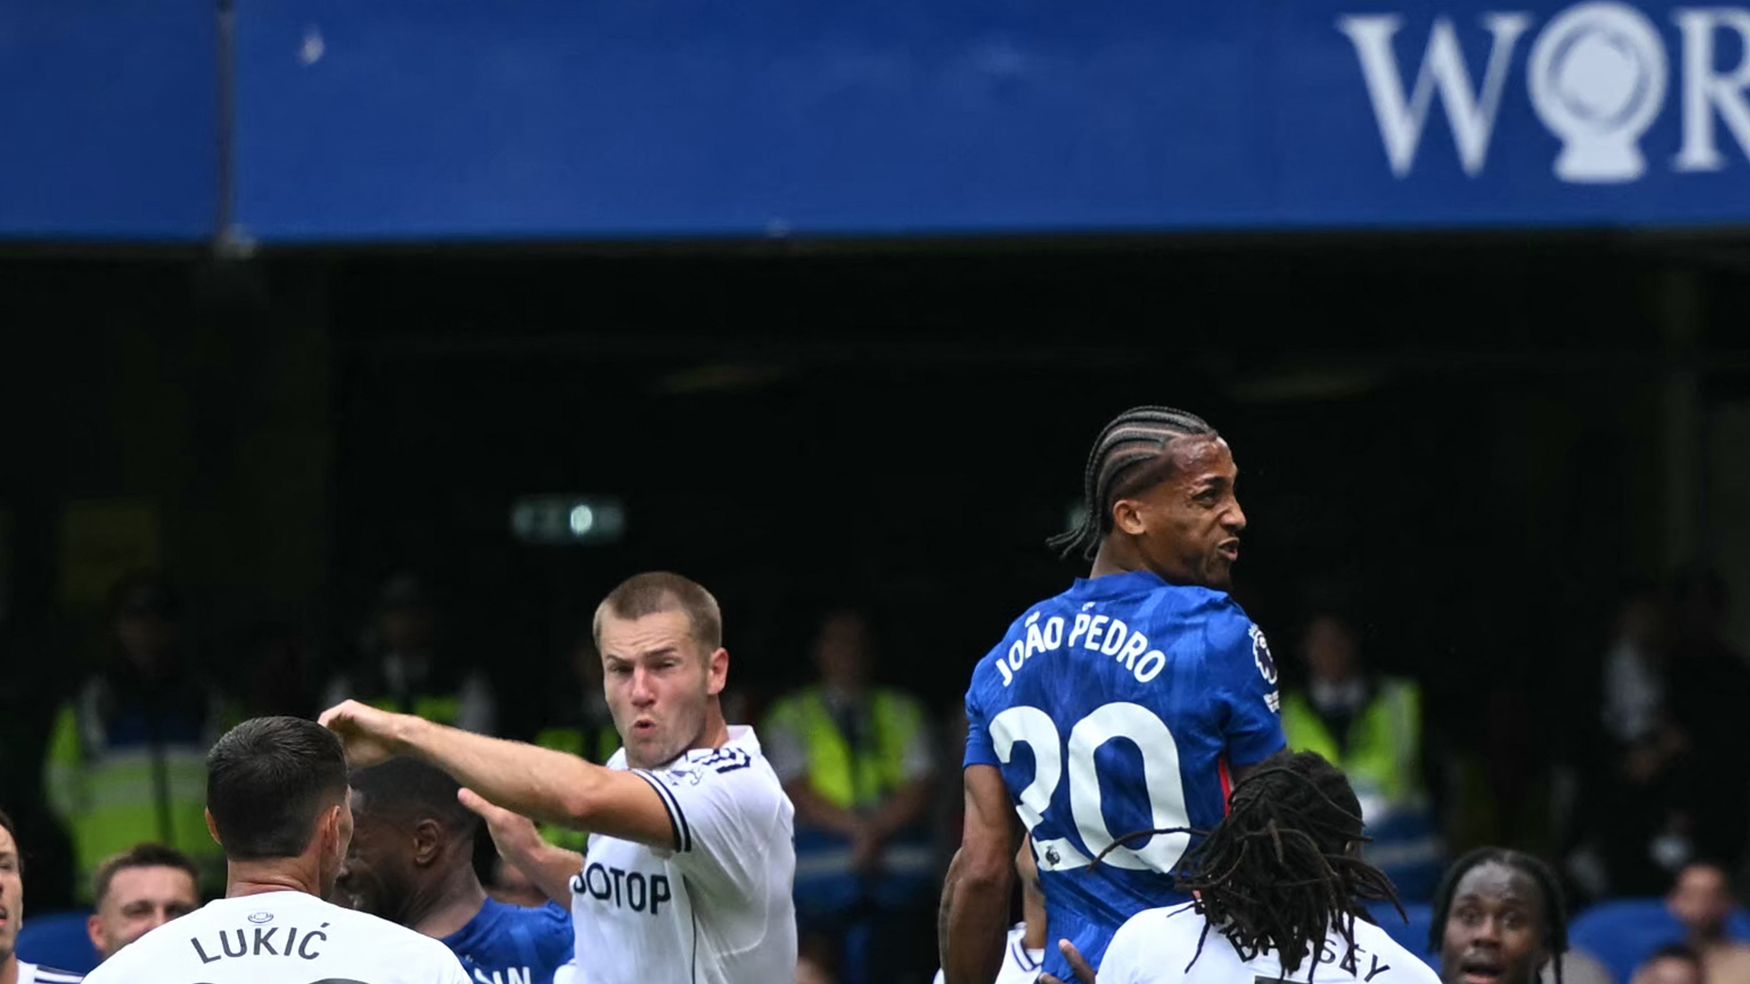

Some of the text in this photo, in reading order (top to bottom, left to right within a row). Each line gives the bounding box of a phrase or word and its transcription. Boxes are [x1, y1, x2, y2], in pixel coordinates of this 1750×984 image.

[995, 610, 1167, 687] JOÃO PEDRO
[989, 700, 1192, 874] 20
[190, 921, 328, 965] LUKIĆ
[1223, 925, 1391, 984] BSEY
